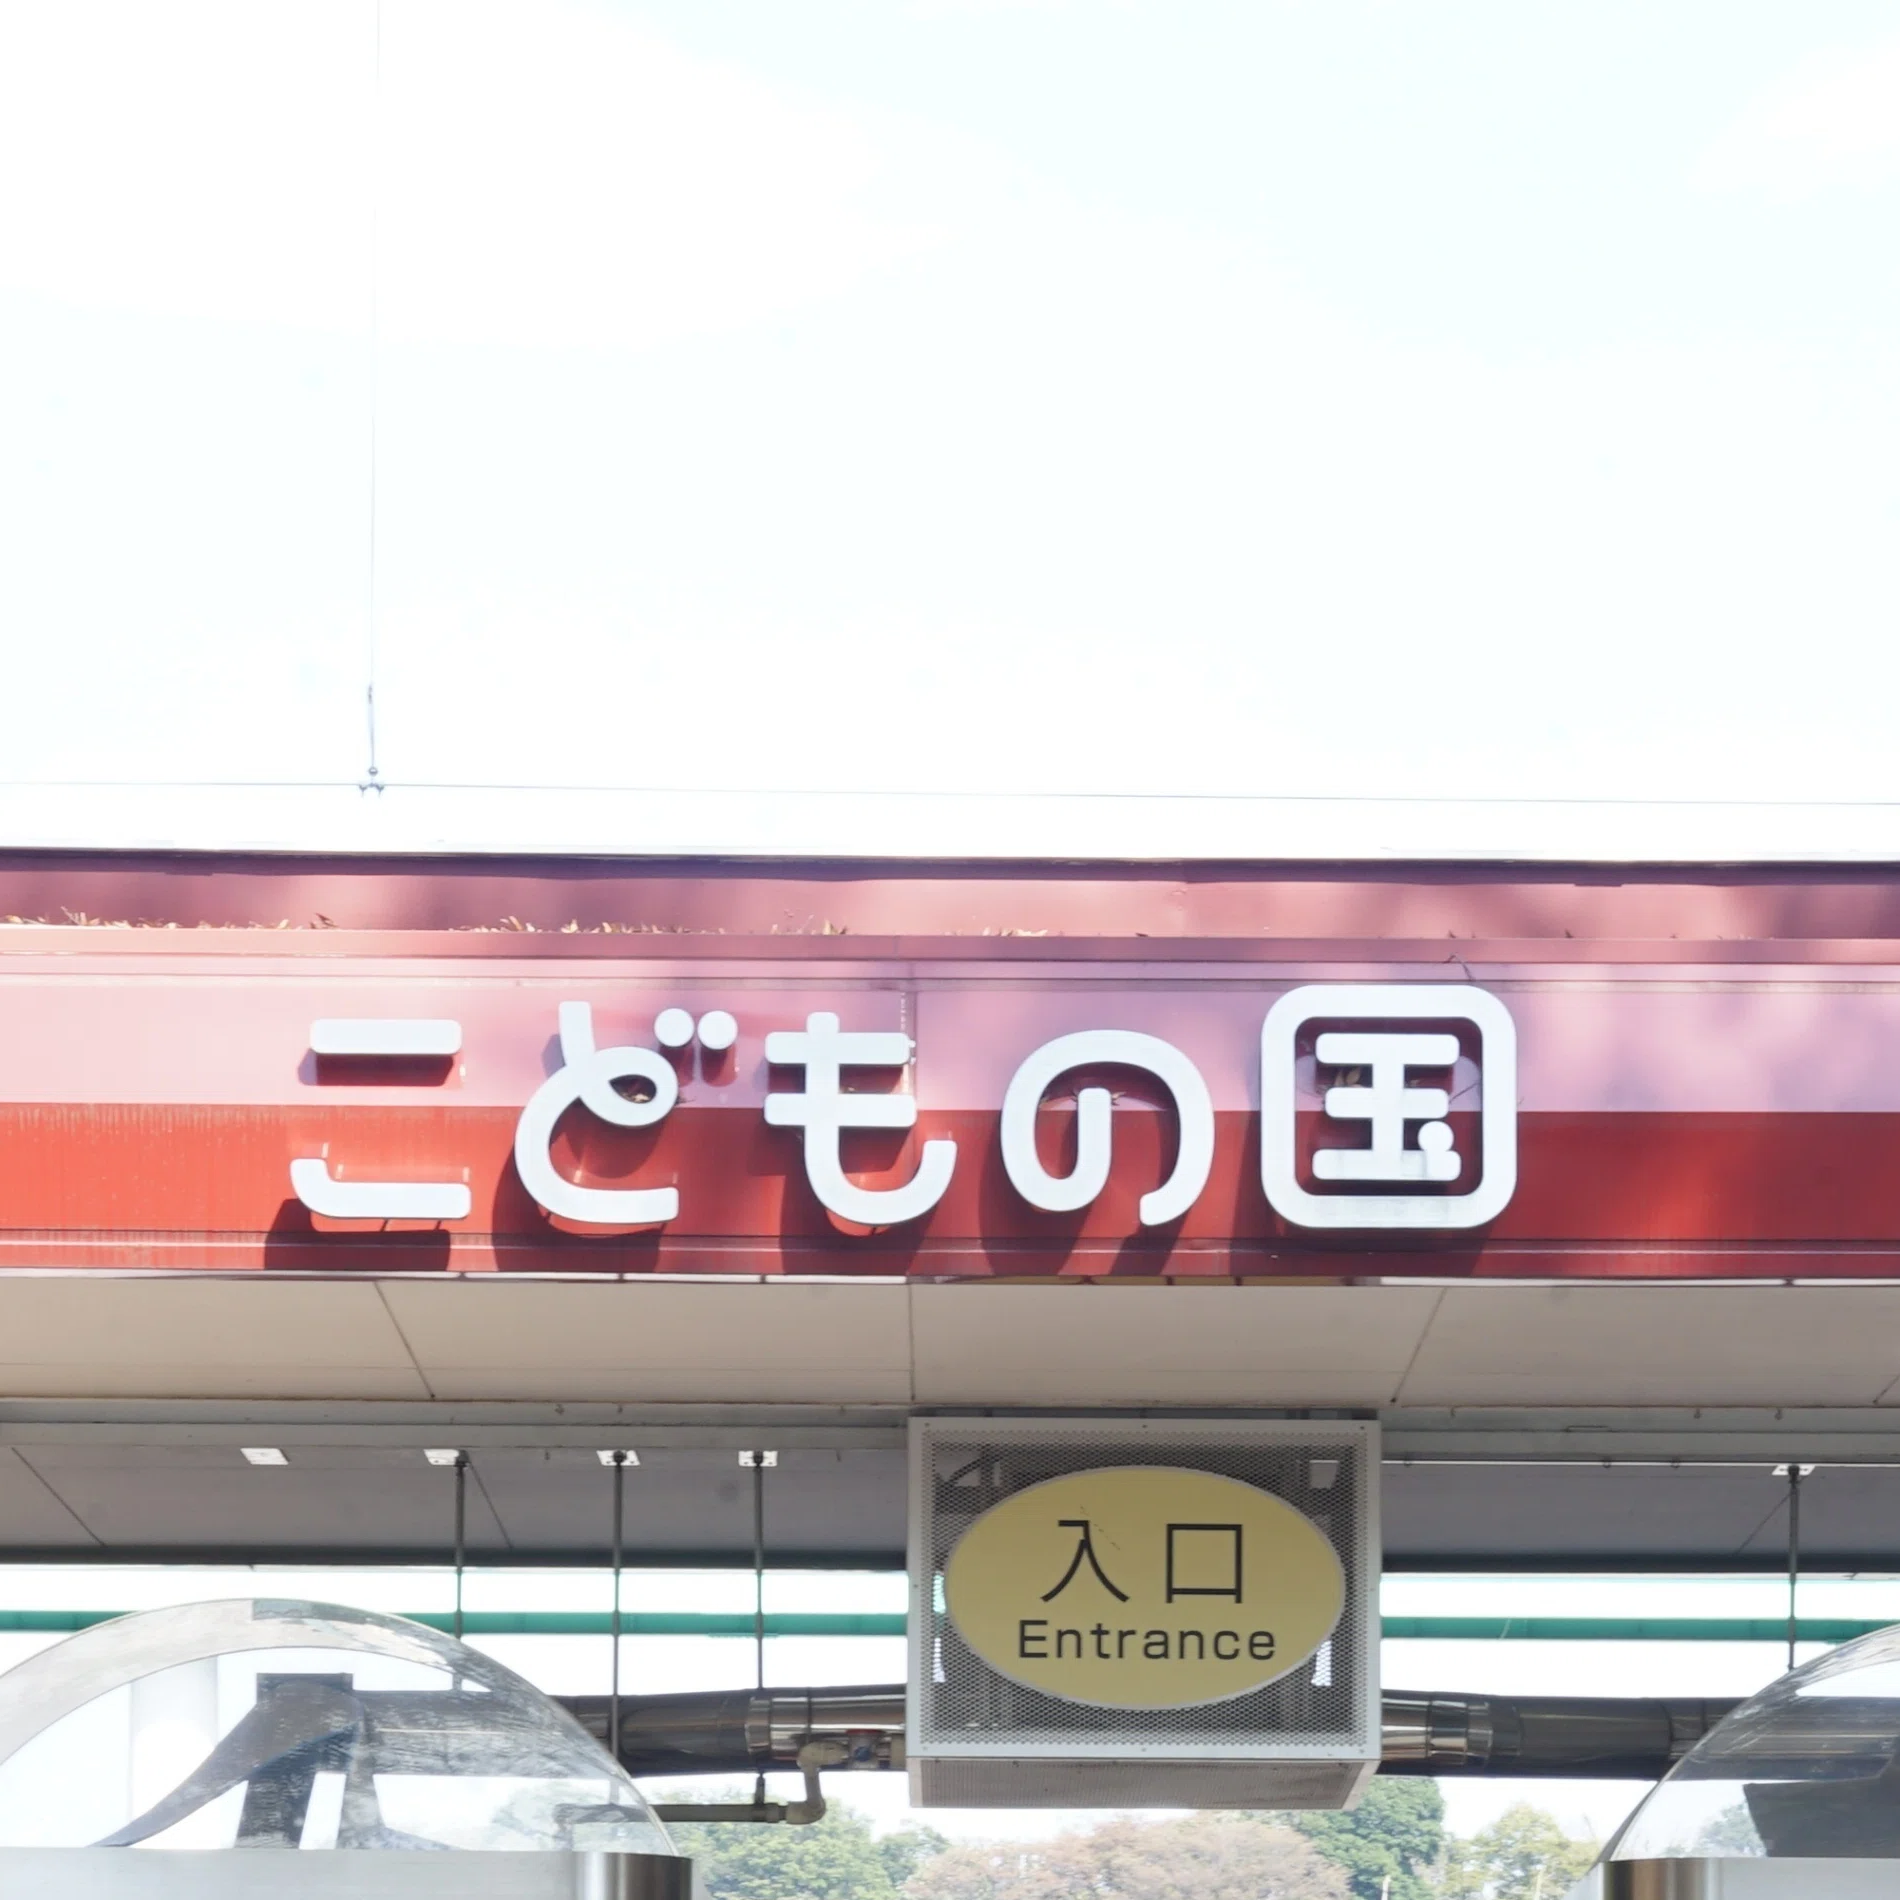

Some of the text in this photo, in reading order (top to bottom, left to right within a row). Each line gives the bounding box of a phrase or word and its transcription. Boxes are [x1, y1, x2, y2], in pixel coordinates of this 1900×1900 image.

[289, 984, 1518, 1228] こどもの国
[1040, 1518, 1244, 1604] 入口
[1018, 1618, 1277, 1661] Entrance
